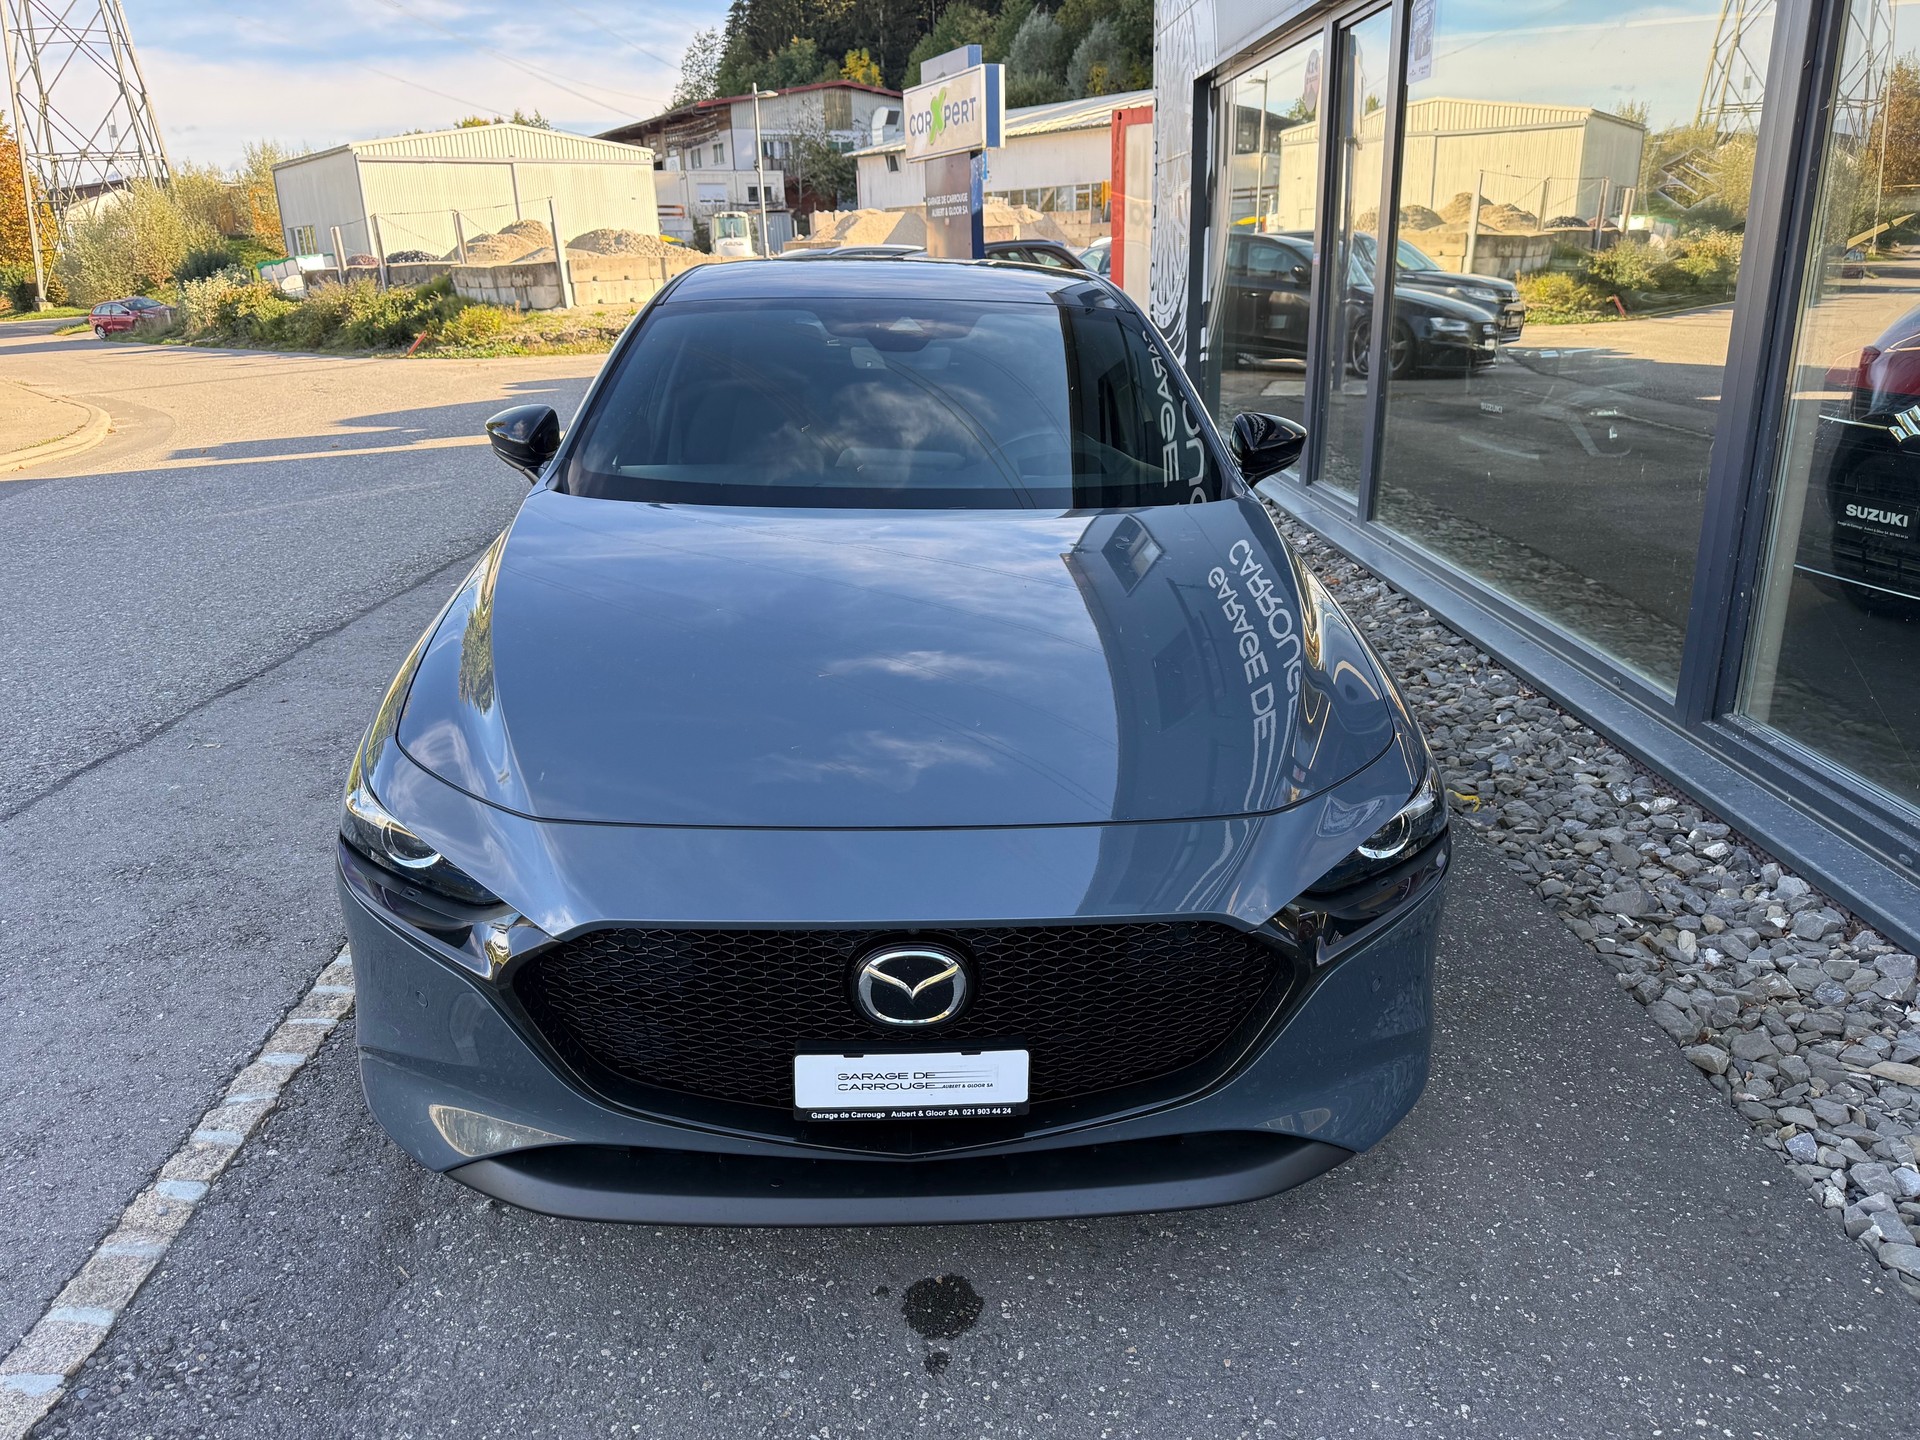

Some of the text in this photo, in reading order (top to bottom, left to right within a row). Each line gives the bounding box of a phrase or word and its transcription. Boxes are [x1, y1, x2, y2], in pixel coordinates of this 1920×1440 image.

[1845, 504, 1908, 527] SUZUKI
[837, 1072, 937, 1081] GARAGE DE
[837, 1082, 938, 1091] CARROUGE
[811, 1112, 839, 1120] Garage
[850, 1111, 886, 1120] Carrouge
[891, 1110, 917, 1118] Aubert
[925, 1109, 947, 1117] Gloor
[962, 1108, 975, 1116] 021
[991, 1107, 1001, 1115] 44
